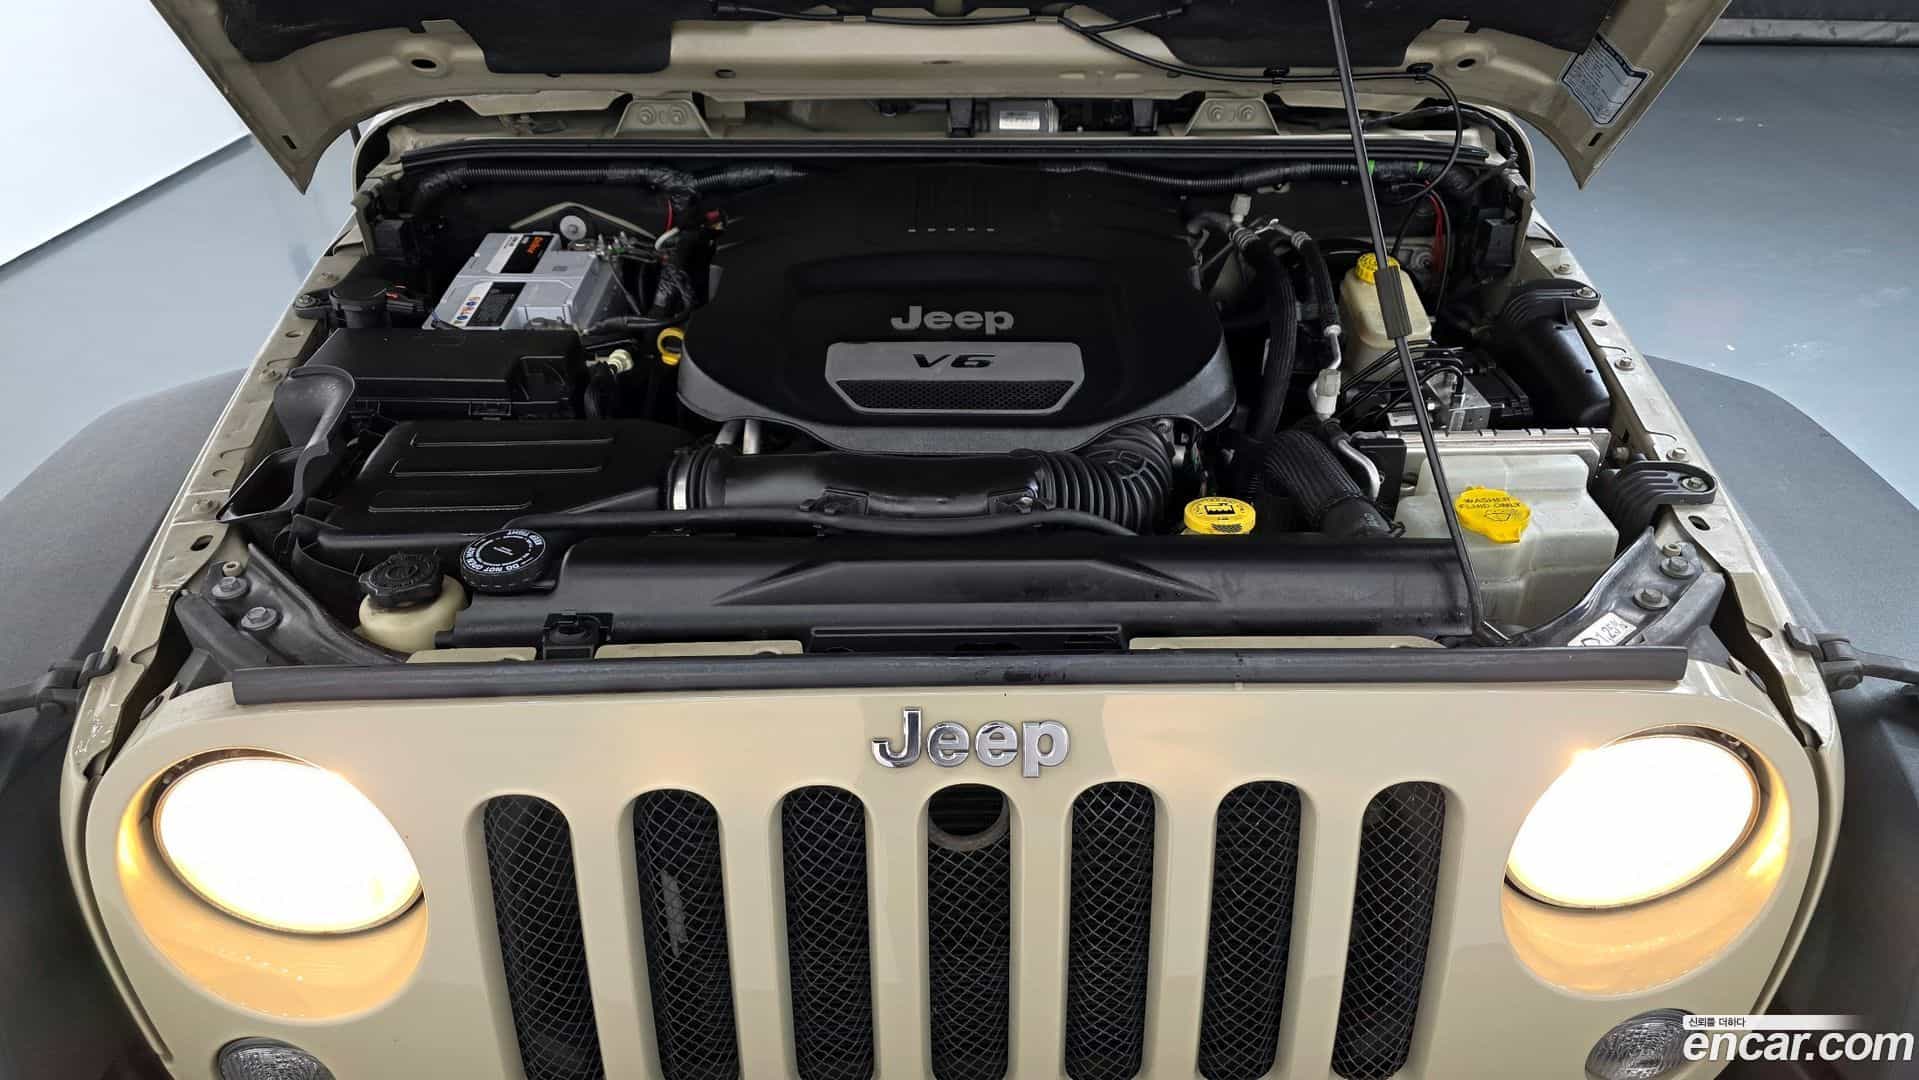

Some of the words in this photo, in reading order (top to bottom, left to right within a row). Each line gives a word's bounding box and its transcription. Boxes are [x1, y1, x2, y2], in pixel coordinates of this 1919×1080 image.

[890, 305, 1014, 335] Jeep
[912, 353, 996, 368] V6
[466, 558, 484, 571] OPEN
[505, 563, 520, 571] DO
[871, 706, 1071, 779] Jeep
